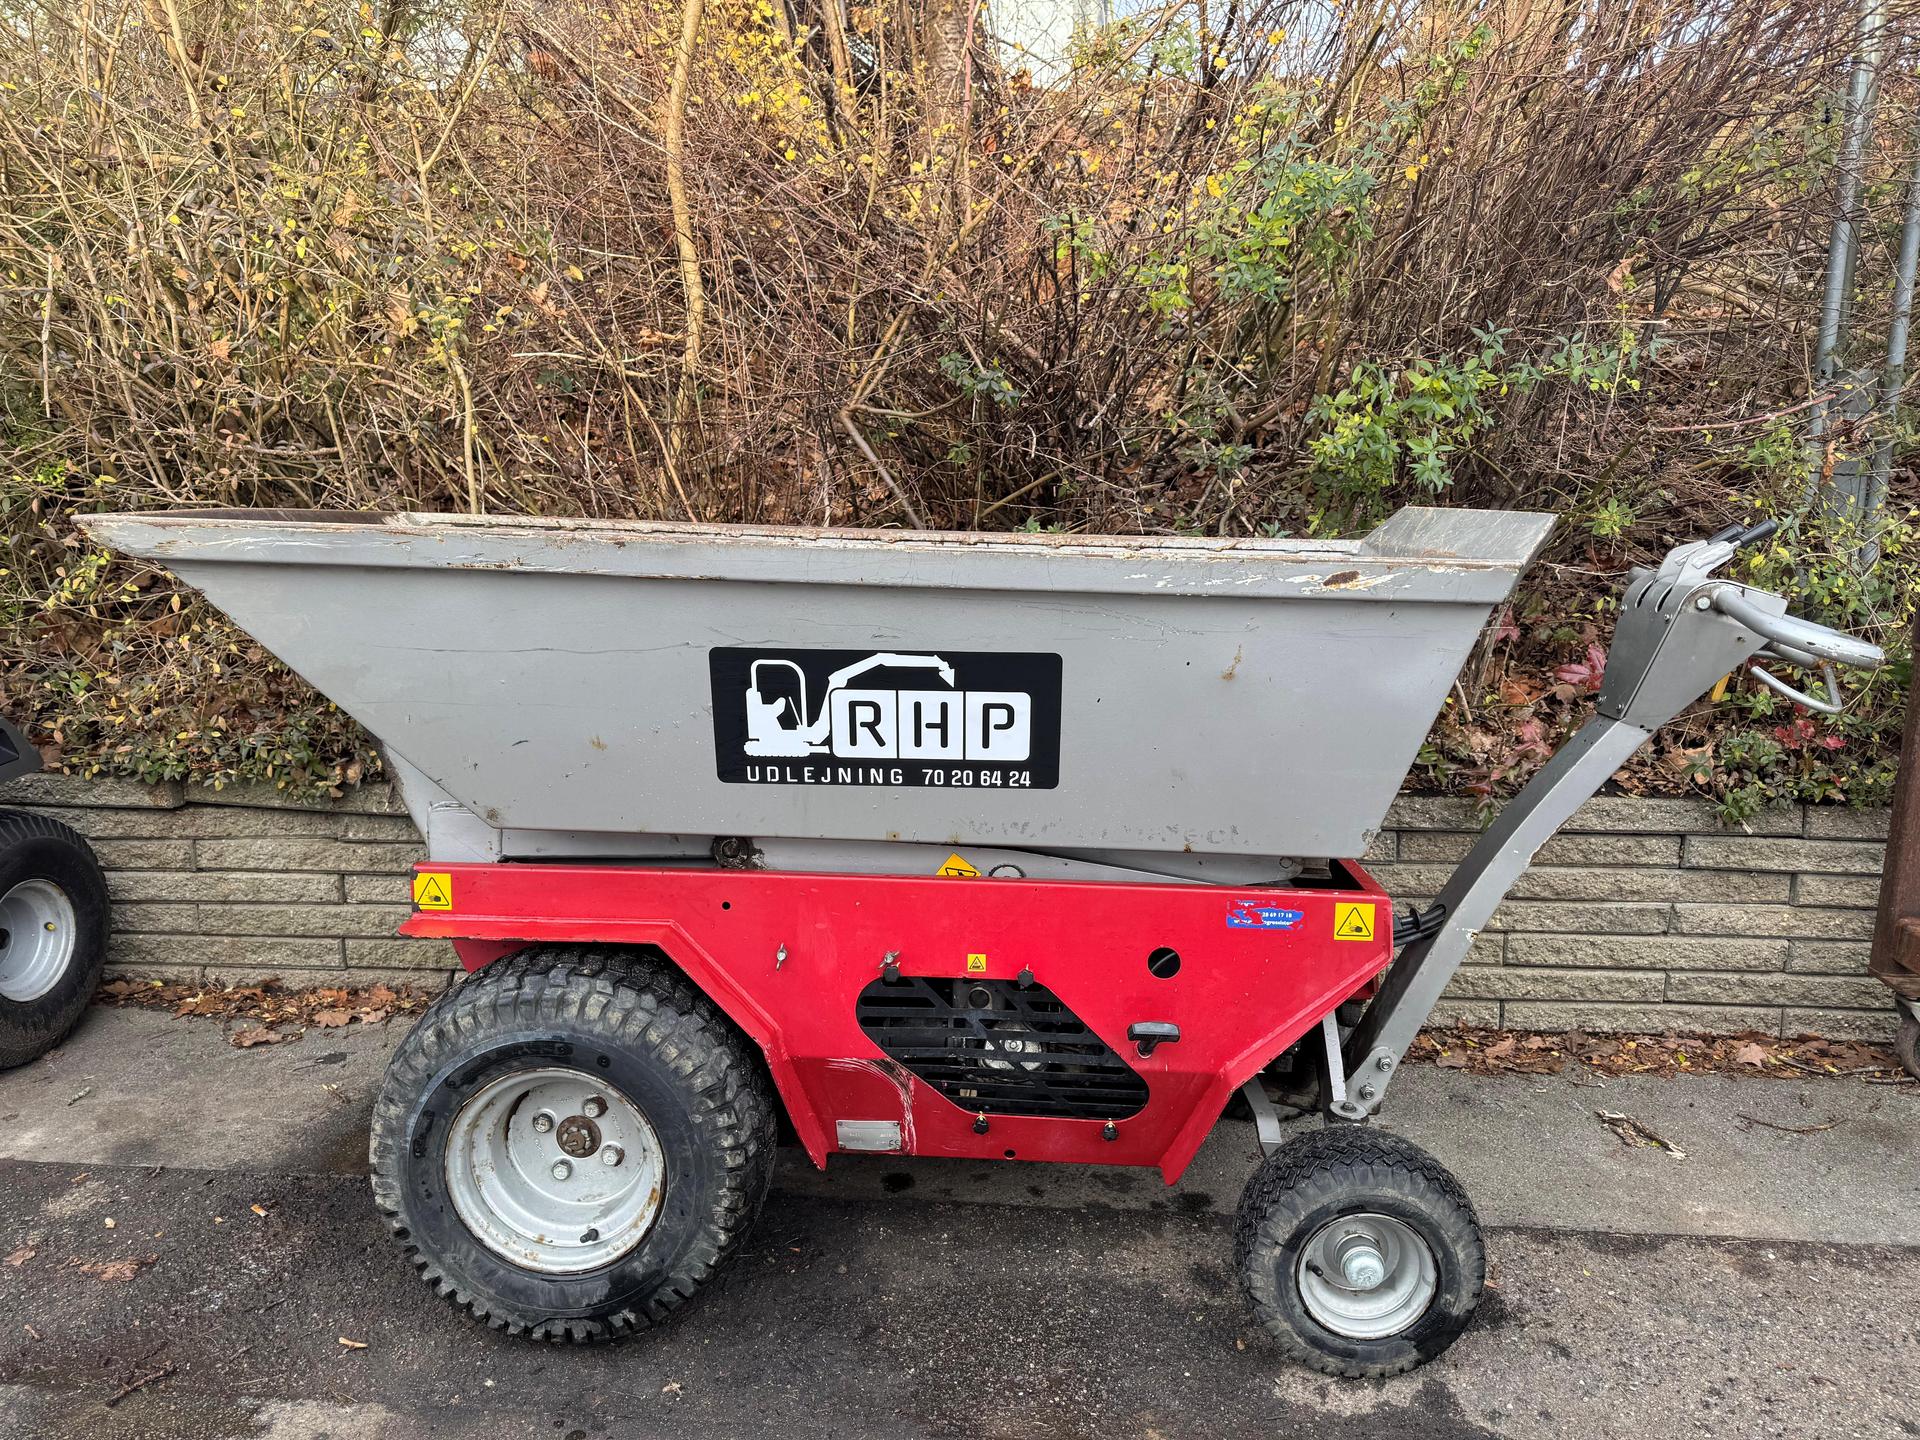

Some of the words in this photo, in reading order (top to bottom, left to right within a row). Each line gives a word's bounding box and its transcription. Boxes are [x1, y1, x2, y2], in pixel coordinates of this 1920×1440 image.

[849, 701, 1015, 749] RHP
[746, 765, 904, 784] UDLEJNING
[922, 769, 944, 786] 70
[951, 769, 973, 786] 20
[980, 770, 1002, 787] 64
[1009, 771, 1031, 788] 24
